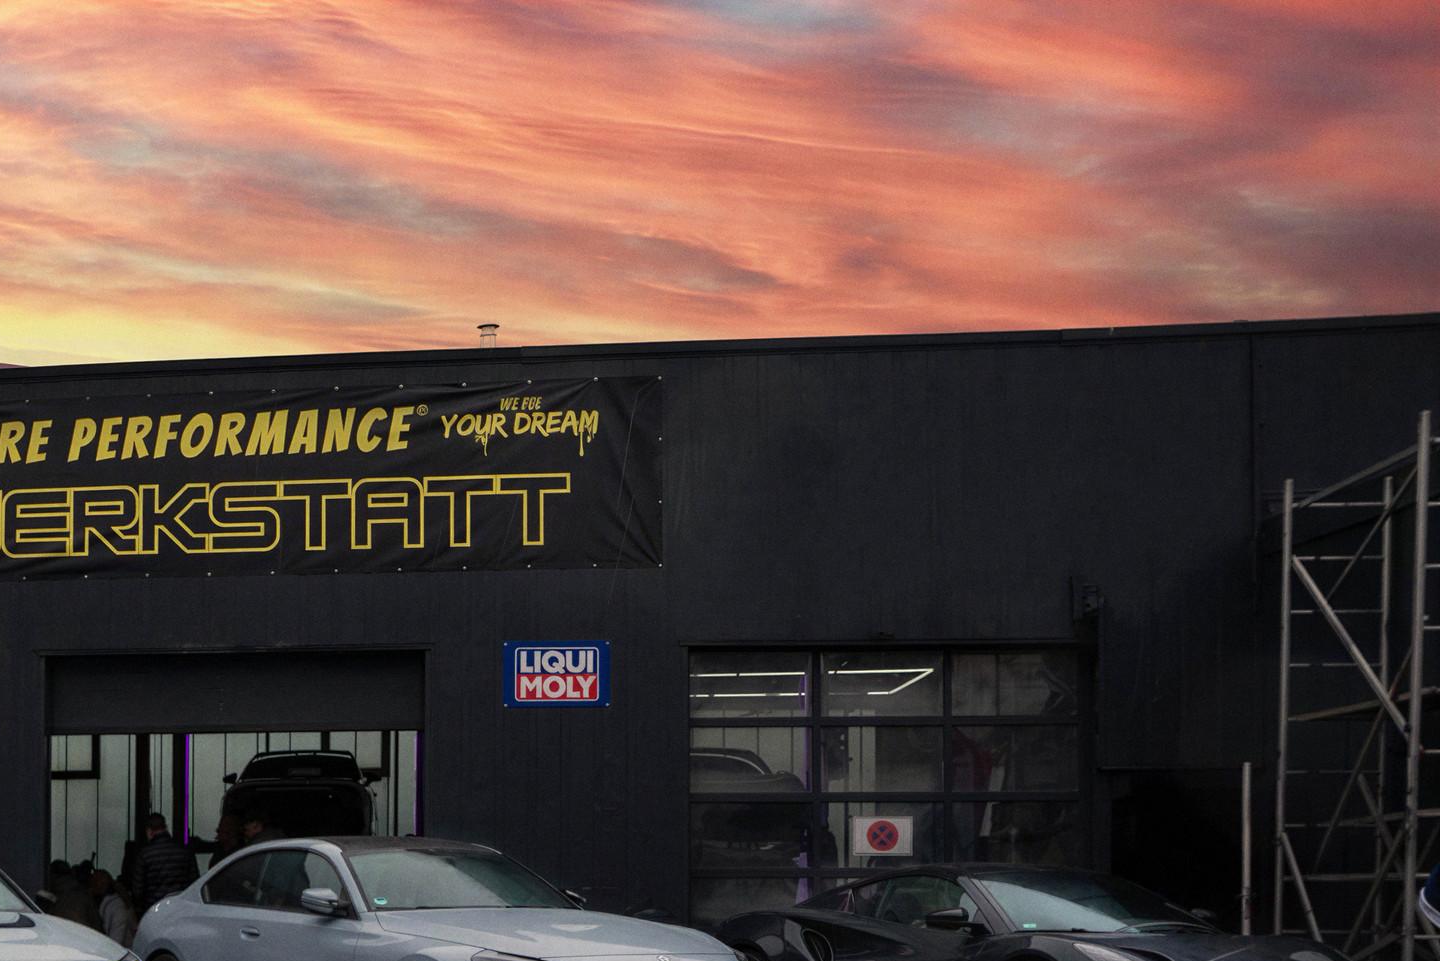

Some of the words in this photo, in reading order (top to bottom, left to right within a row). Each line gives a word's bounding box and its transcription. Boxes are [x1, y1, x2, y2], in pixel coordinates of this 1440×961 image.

[441, 413, 508, 445] YOUR
[513, 410, 599, 445] DREAM
[519, 650, 594, 674] LIQUI
[520, 675, 597, 698] MOLY
